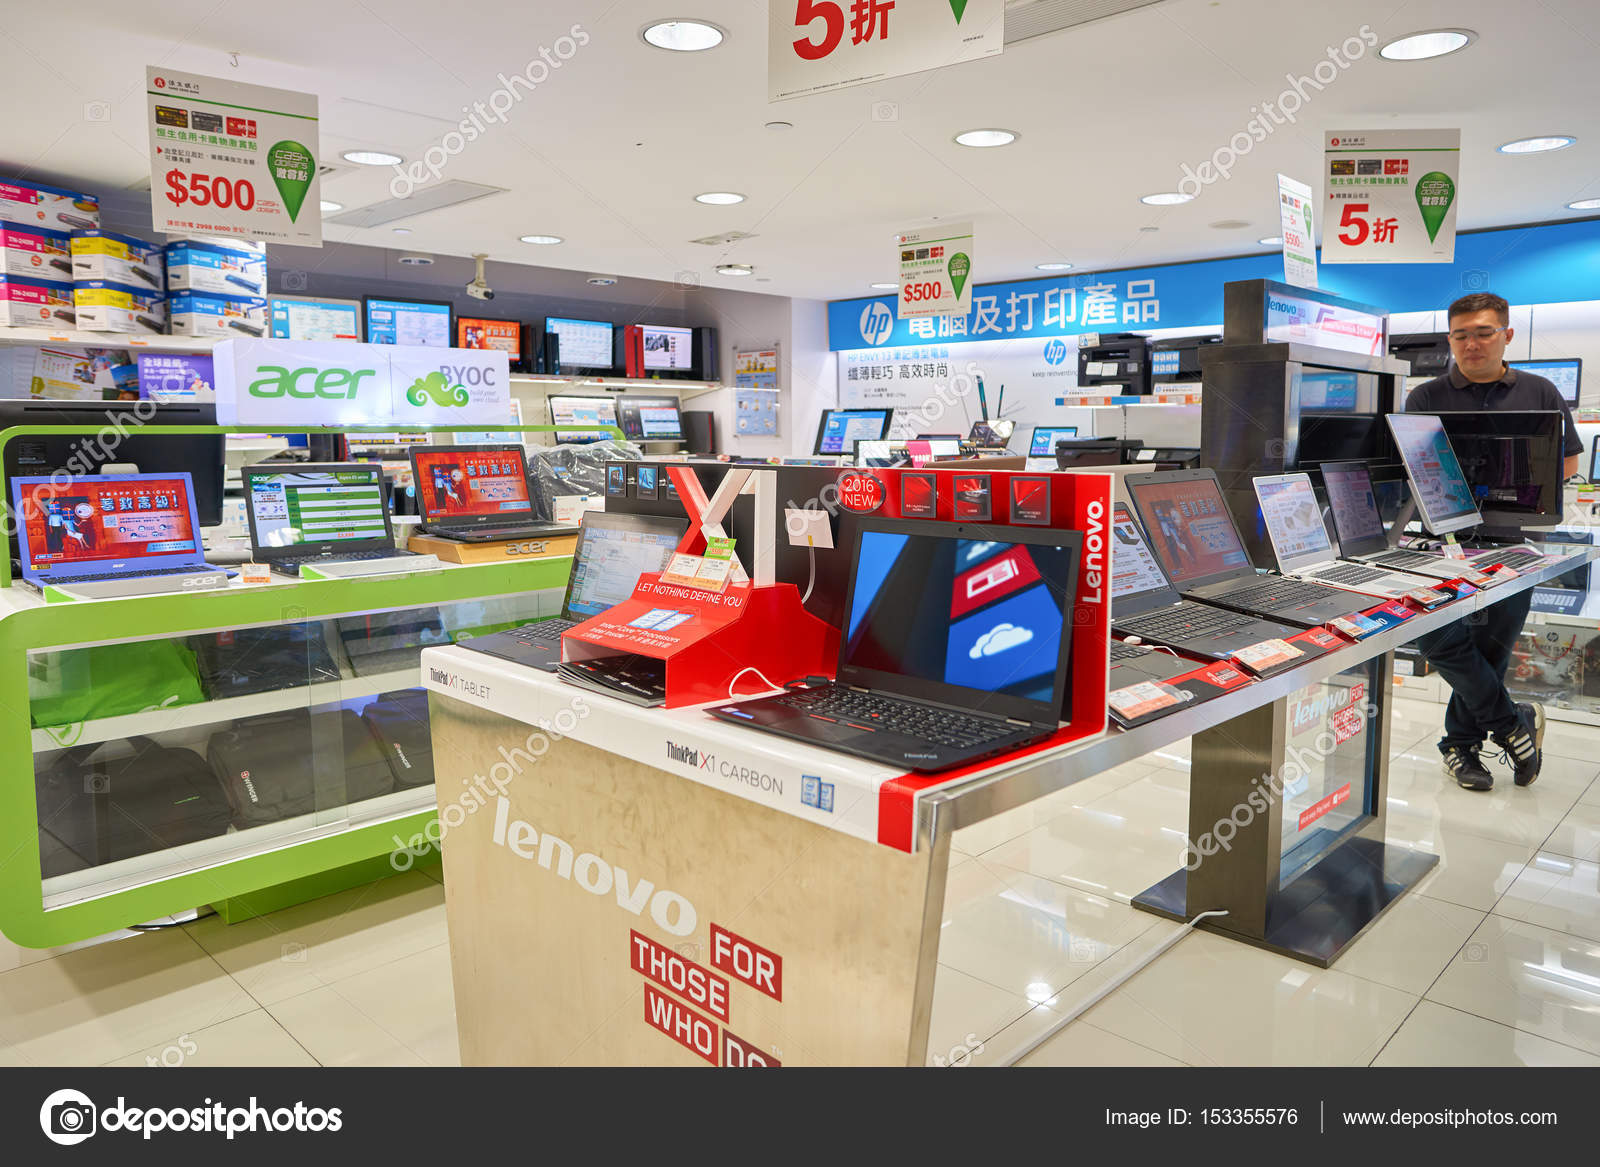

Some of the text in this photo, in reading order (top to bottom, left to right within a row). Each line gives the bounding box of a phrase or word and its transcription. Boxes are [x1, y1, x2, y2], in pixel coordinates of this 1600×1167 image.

[165, 168, 255, 211] $500
[1338, 203, 1399, 246] 5折
[903, 281, 941, 303] $500
[864, 303, 891, 344] hp
[248, 365, 376, 399] acer
[439, 365, 496, 387] BYOC
[898, 362, 949, 379] 高效時尚
[844, 479, 875, 493] 2016
[844, 493, 875, 507] NEW
[505, 540, 550, 556] acer
[1082, 500, 1104, 604] Lenovo
[181, 574, 225, 587] acer
[638, 582, 743, 608] LET NOTHING DEFINE YOU
[449, 673, 457, 689] X1
[460, 678, 490, 699] TABLET
[1294, 687, 1348, 728] lenovo
[665, 740, 698, 767] ThinkPad
[700, 750, 716, 773] X1
[719, 761, 783, 796] CARBON
[493, 795, 697, 937] lenovo
[633, 936, 726, 1016] THOSE
[715, 931, 776, 994] FOR
[649, 991, 713, 1056] WHO
